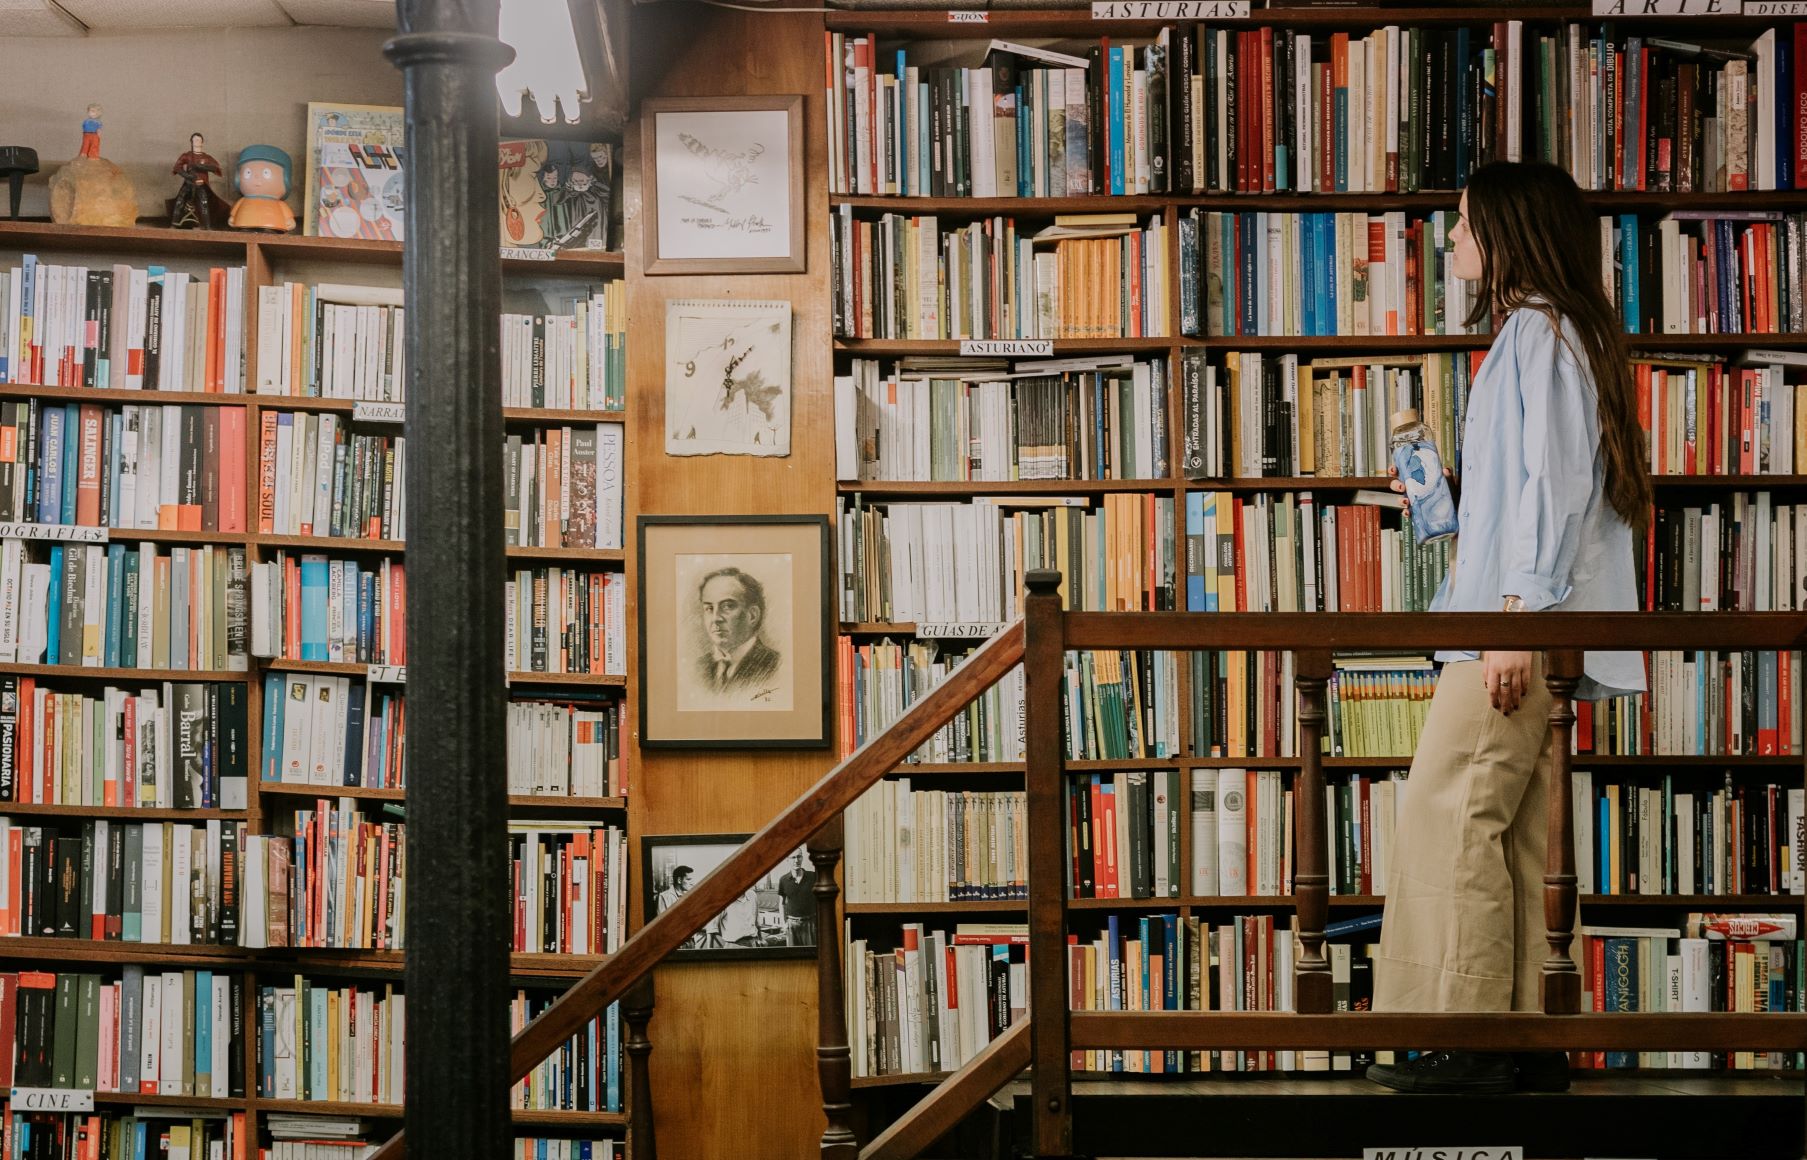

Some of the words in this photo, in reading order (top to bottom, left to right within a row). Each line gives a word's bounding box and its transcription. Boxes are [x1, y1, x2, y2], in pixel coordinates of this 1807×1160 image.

[1102, 2, 1239, 18] ASTURIAS
[1609, 0, 1722, 14] ARTE
[1606, 42, 1615, 71] DIBUJO
[1608, 72, 1614, 82] DE
[1184, 114, 1190, 122] DE
[967, 342, 1047, 354] ASTURIANO
[684, 362, 696, 377] 9
[1190, 372, 1199, 402] PARAÍSO
[1191, 403, 1199, 412] AL
[49, 414, 60, 437] JUAN
[264, 415, 276, 437] THE
[1191, 414, 1200, 450] ENTRADAS
[49, 438, 59, 475] CARLOS
[83, 418, 98, 480] SALINGER
[319, 435, 332, 470] JPod
[574, 449, 596, 457] Auster
[576, 439, 592, 449] Paul
[384, 451, 393, 464] PAUL
[602, 433, 617, 491] PESSOA
[261, 493, 273, 523] SOUL
[67, 548, 78, 561] Gil
[67, 561, 77, 572] de
[234, 555, 244, 582] BRUCE
[66, 573, 77, 604] Biedma
[234, 584, 244, 637] SPRINGSTEEN
[922, 622, 965, 637] GUÍAS
[968, 625, 989, 637] DE
[180, 710, 197, 758] Barral
[1017, 699, 1026, 744] Asturias
[1, 723, 13, 786] PASIONARIA
[1796, 815, 1807, 873] FASHION
[1728, 920, 1760, 936] CIRCUS
[1110, 959, 1121, 1000] ASTURIAS
[1671, 968, 1679, 1001] T-SHIRT
[26, 1093, 71, 1109] CINE
